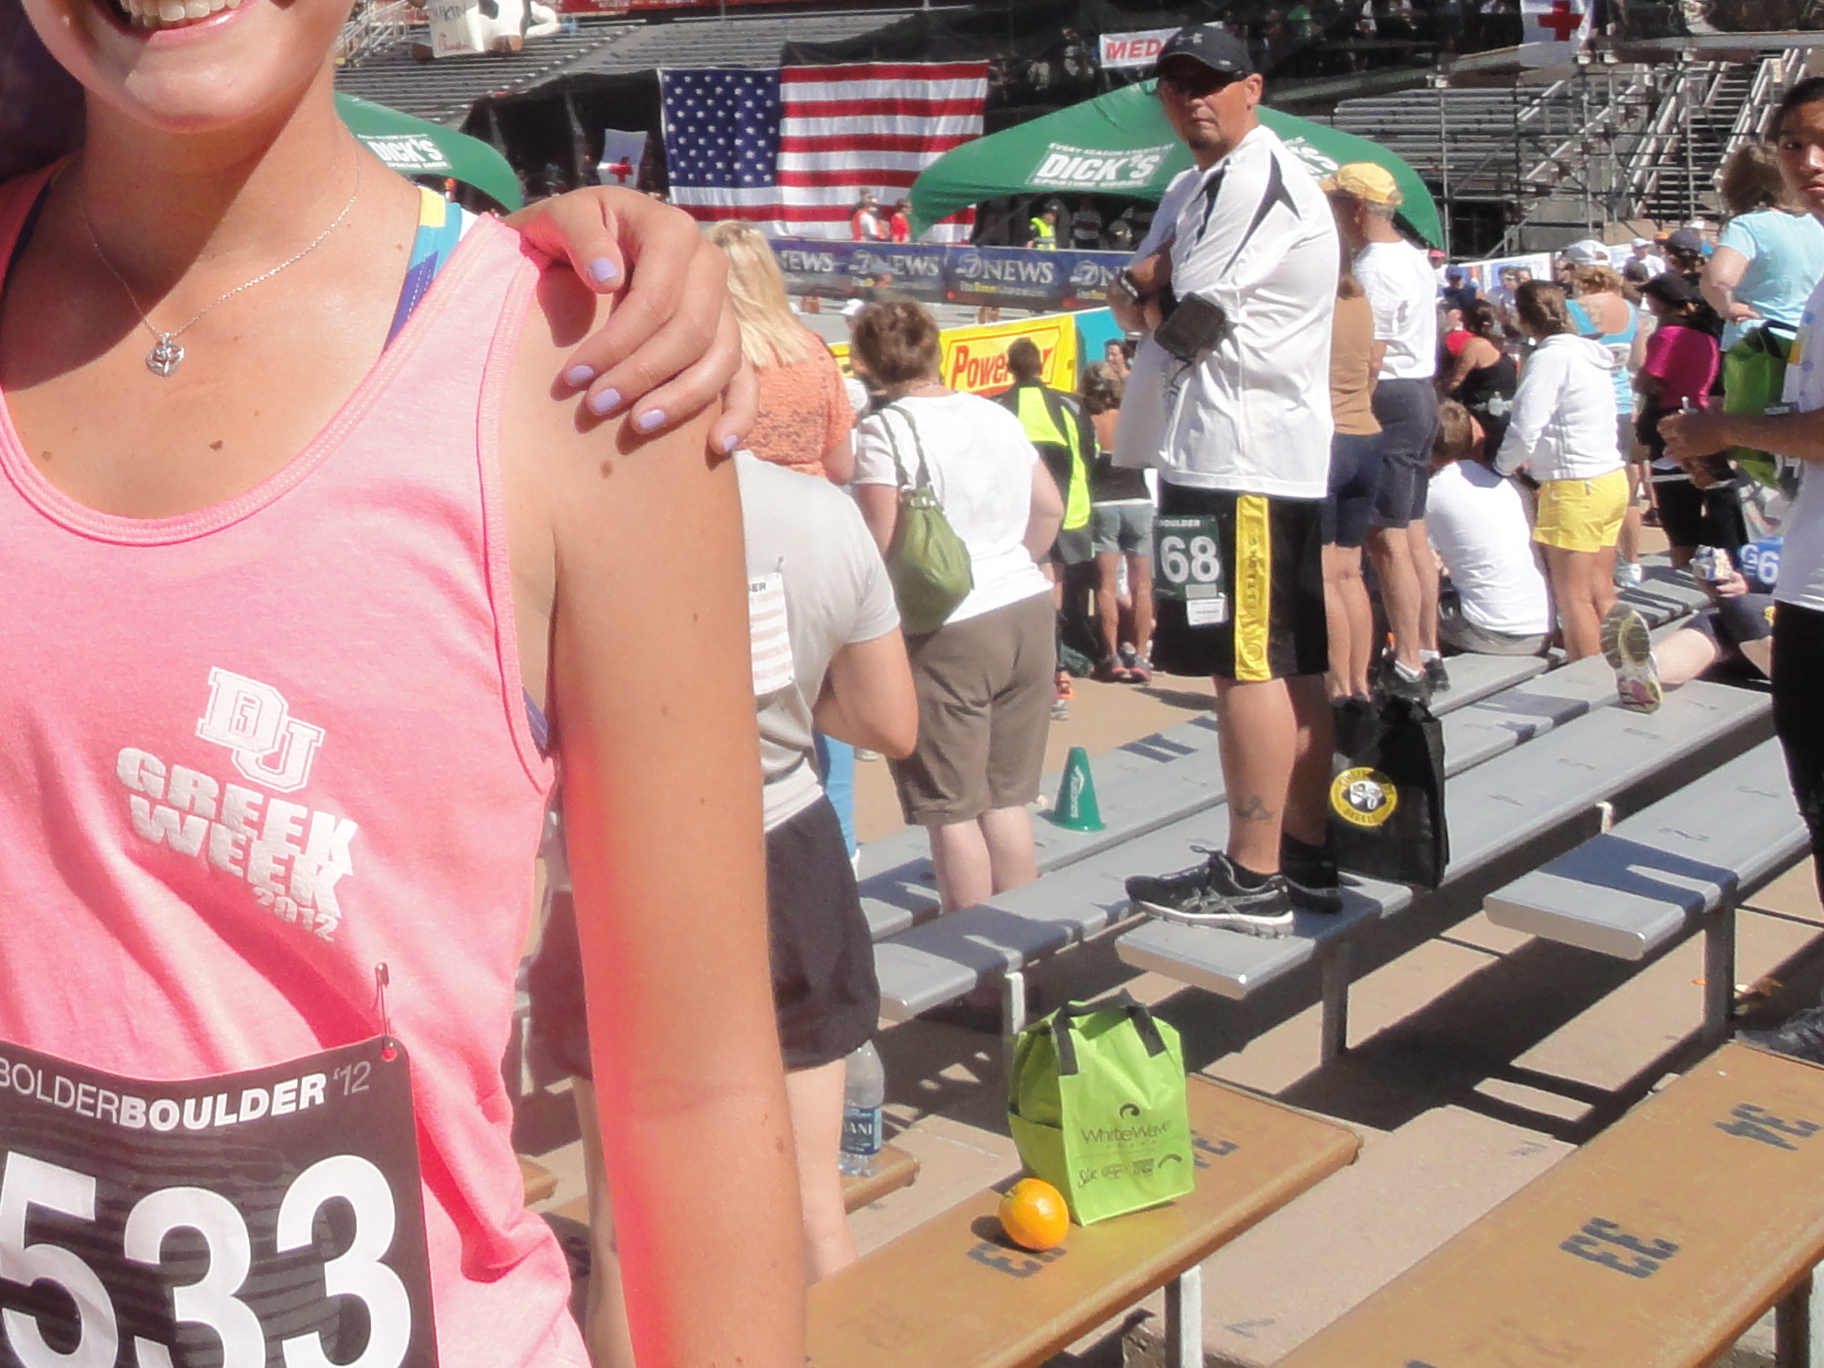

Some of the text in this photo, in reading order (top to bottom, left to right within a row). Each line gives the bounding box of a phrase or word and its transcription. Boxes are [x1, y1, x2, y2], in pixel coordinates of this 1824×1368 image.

[1105, 38, 1165, 61] MED
[367, 138, 444, 163] DICK'S
[1036, 152, 1160, 181] DICK'S
[1160, 535, 1221, 583] 68
[194, 665, 326, 793] DU
[115, 747, 358, 876] GREEK
[129, 794, 343, 919] WEEK
[252, 886, 340, 943] 2012
[1080, 1121, 1169, 1143] WhiteWave
